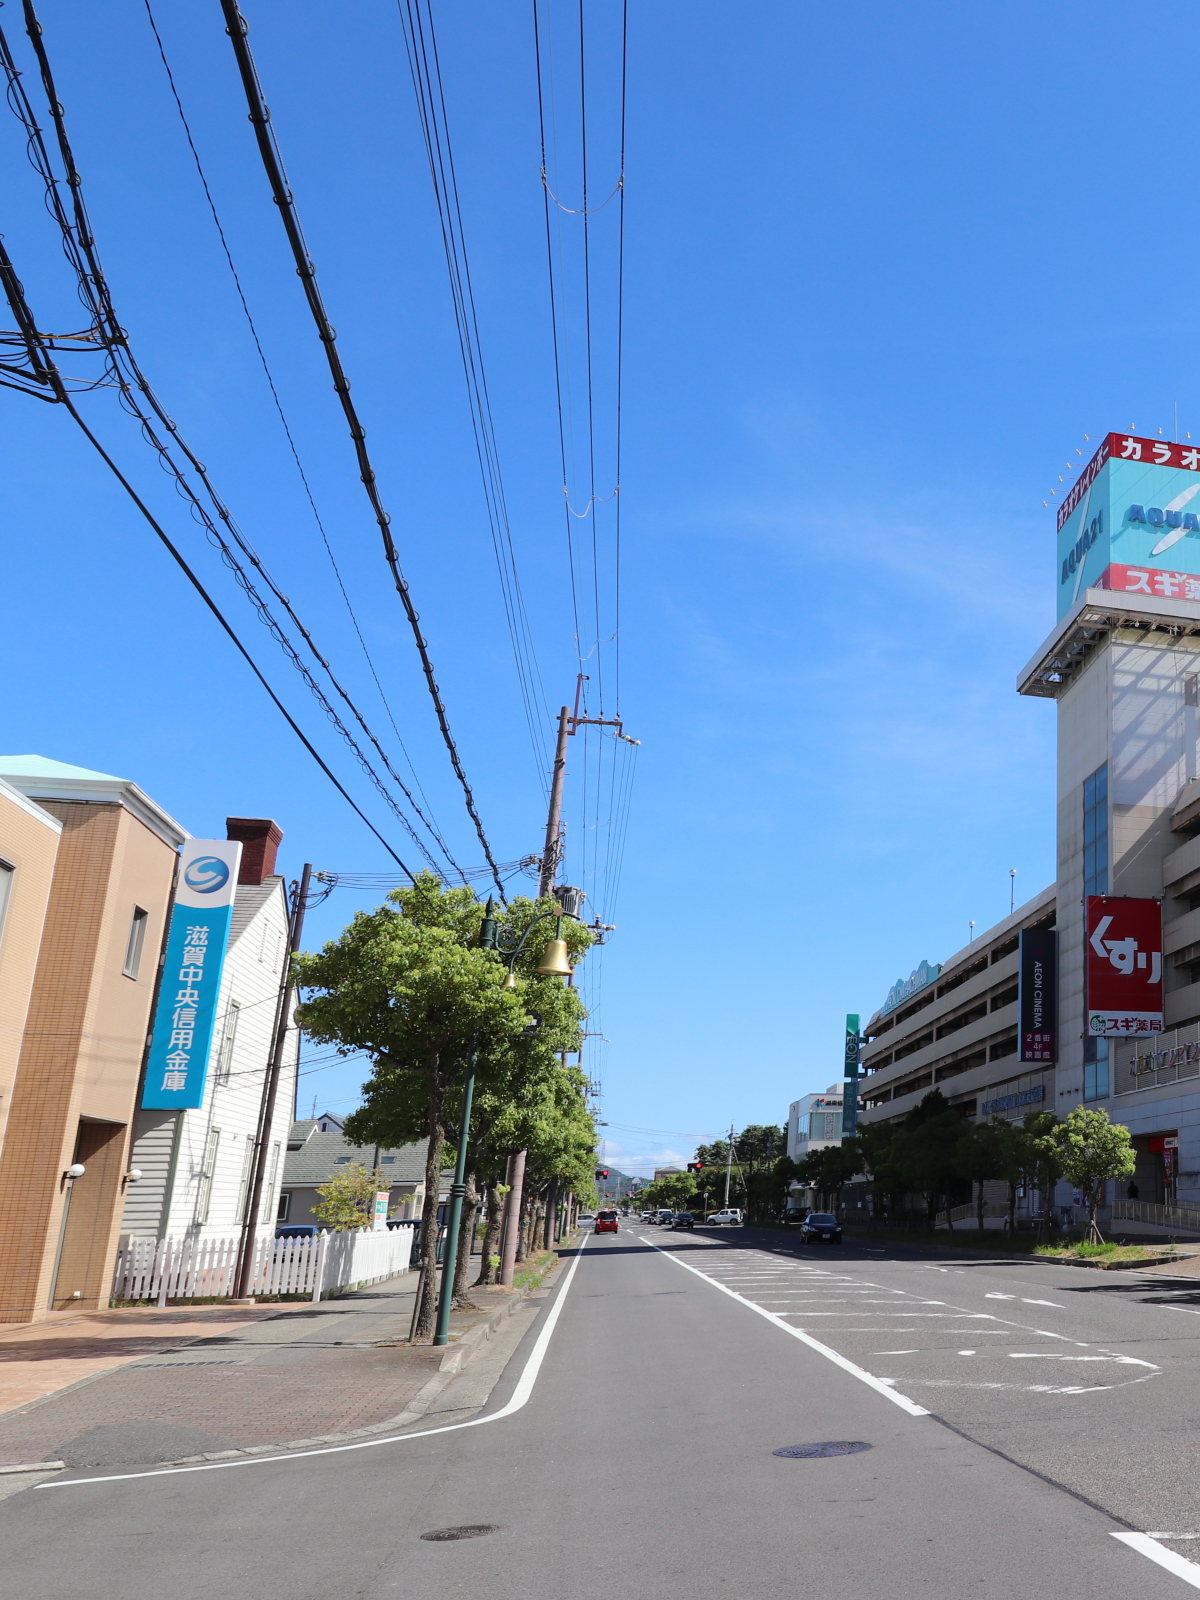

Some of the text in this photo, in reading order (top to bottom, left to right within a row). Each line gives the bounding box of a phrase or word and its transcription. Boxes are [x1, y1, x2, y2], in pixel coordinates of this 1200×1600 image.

[1061, 508, 1104, 585] AQUA21
[1089, 915, 1162, 983] くすり
[160, 925, 210, 1092] 滋賀中央信用金庫
[1034, 961, 1043, 1028] AEON CINEMA
[1106, 1016, 1162, 1031] スギ薬局
